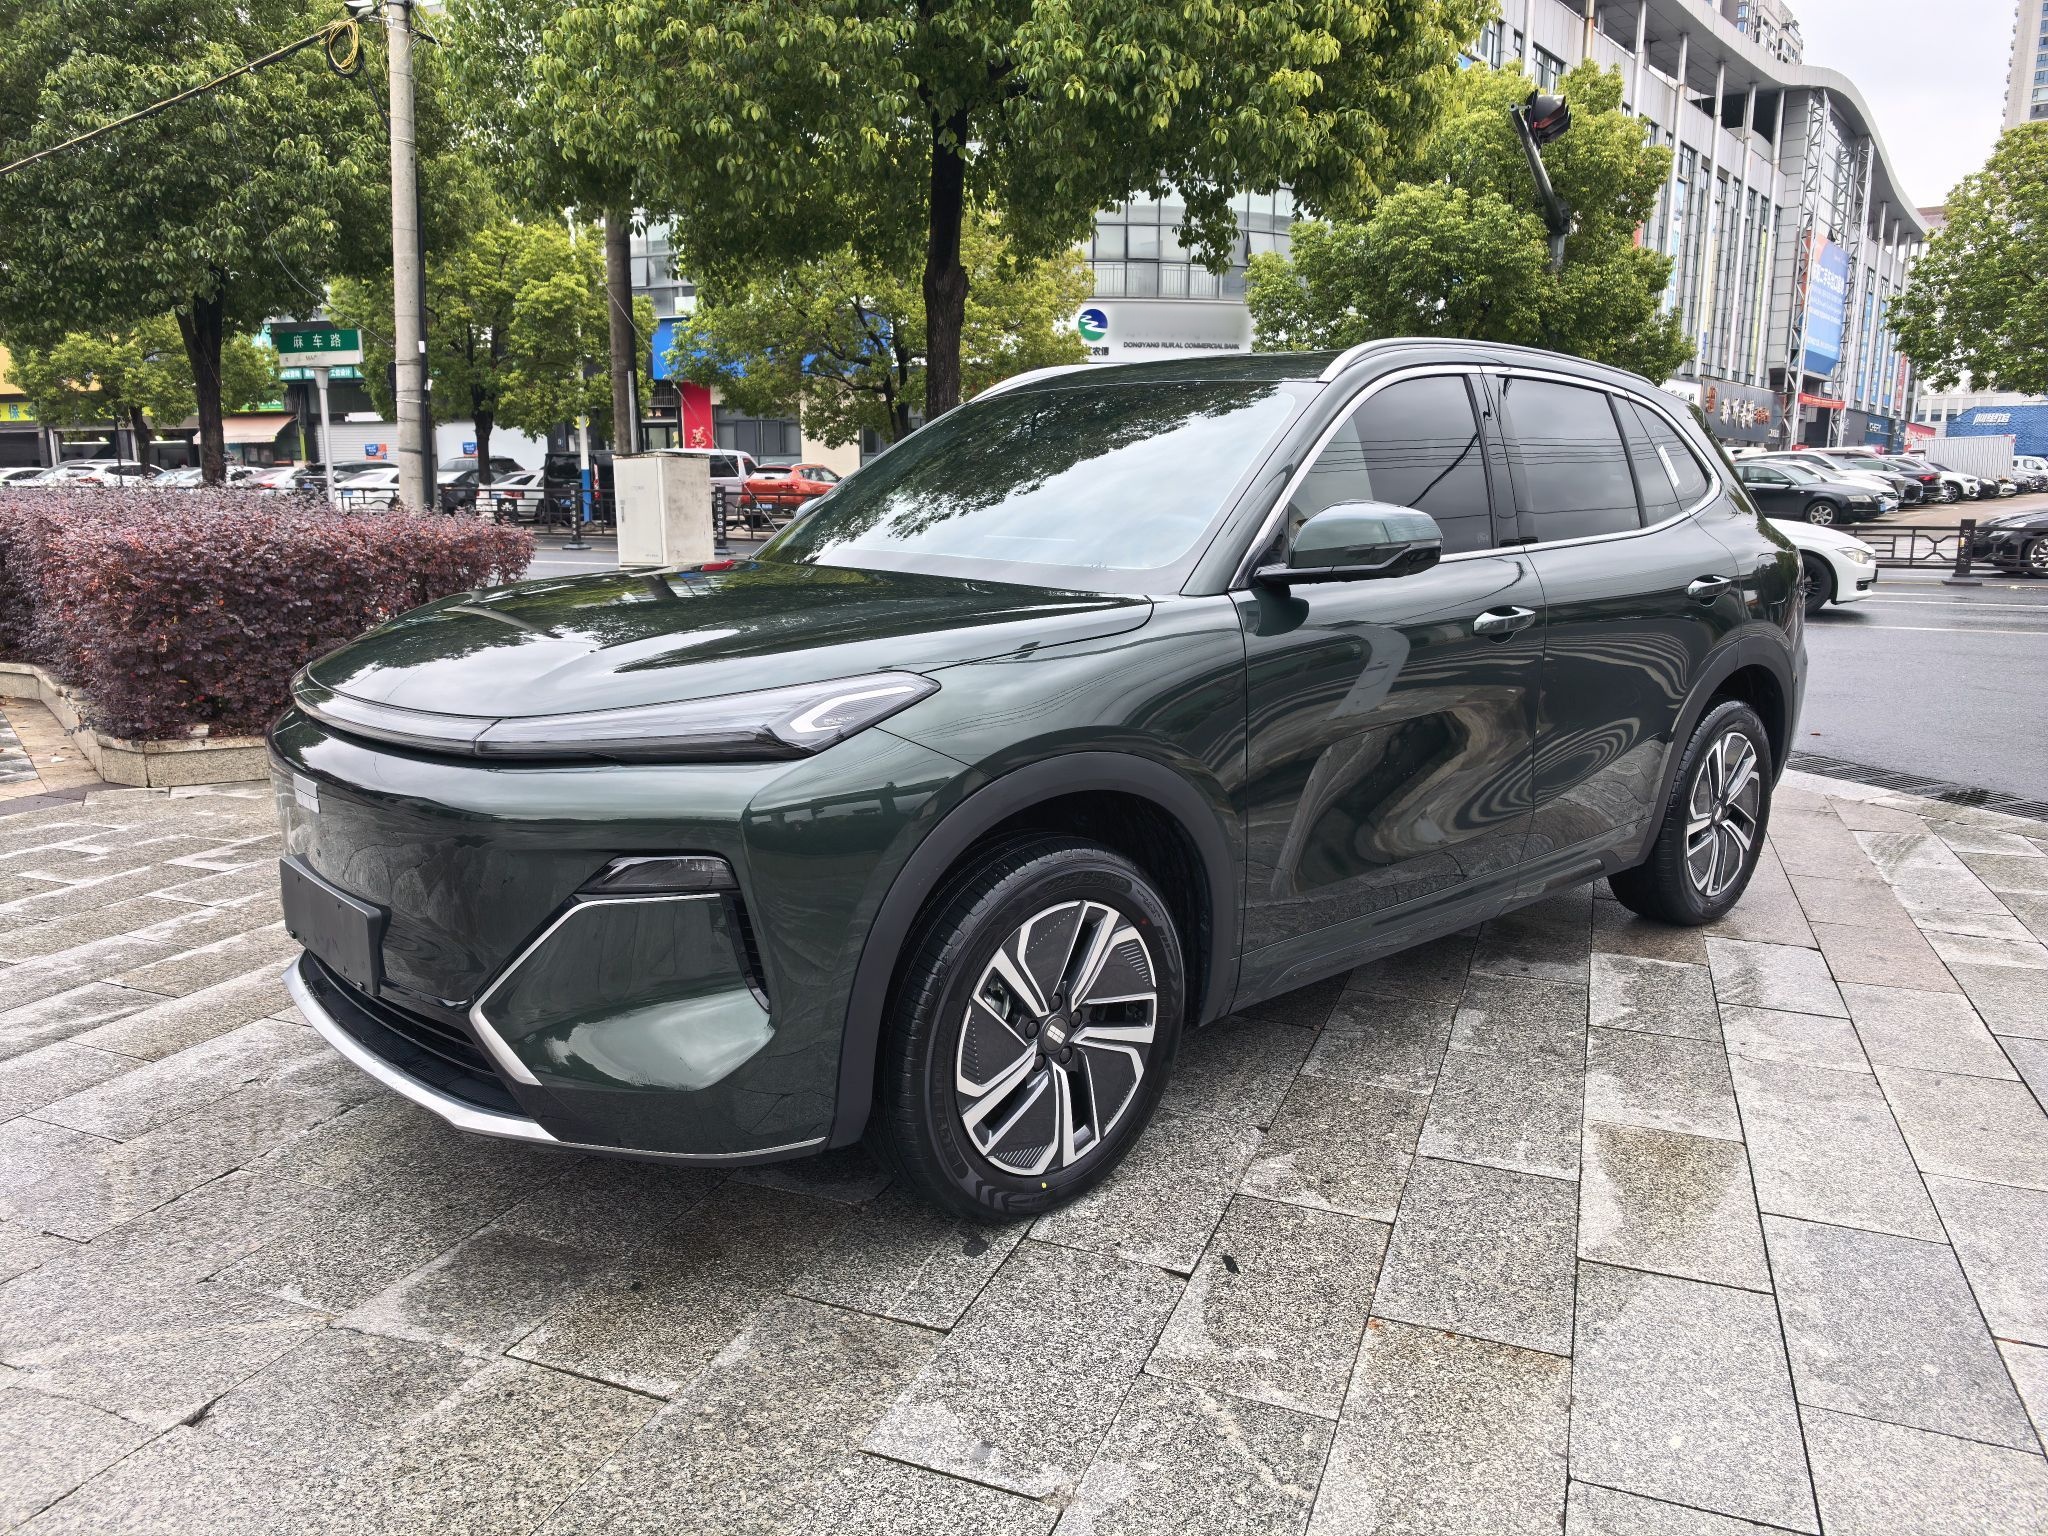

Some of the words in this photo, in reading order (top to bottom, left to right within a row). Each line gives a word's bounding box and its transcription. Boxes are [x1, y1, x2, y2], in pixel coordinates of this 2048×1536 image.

[293, 333, 341, 349] 麻车路
[1184, 342, 1223, 350] COMMERCIAL
